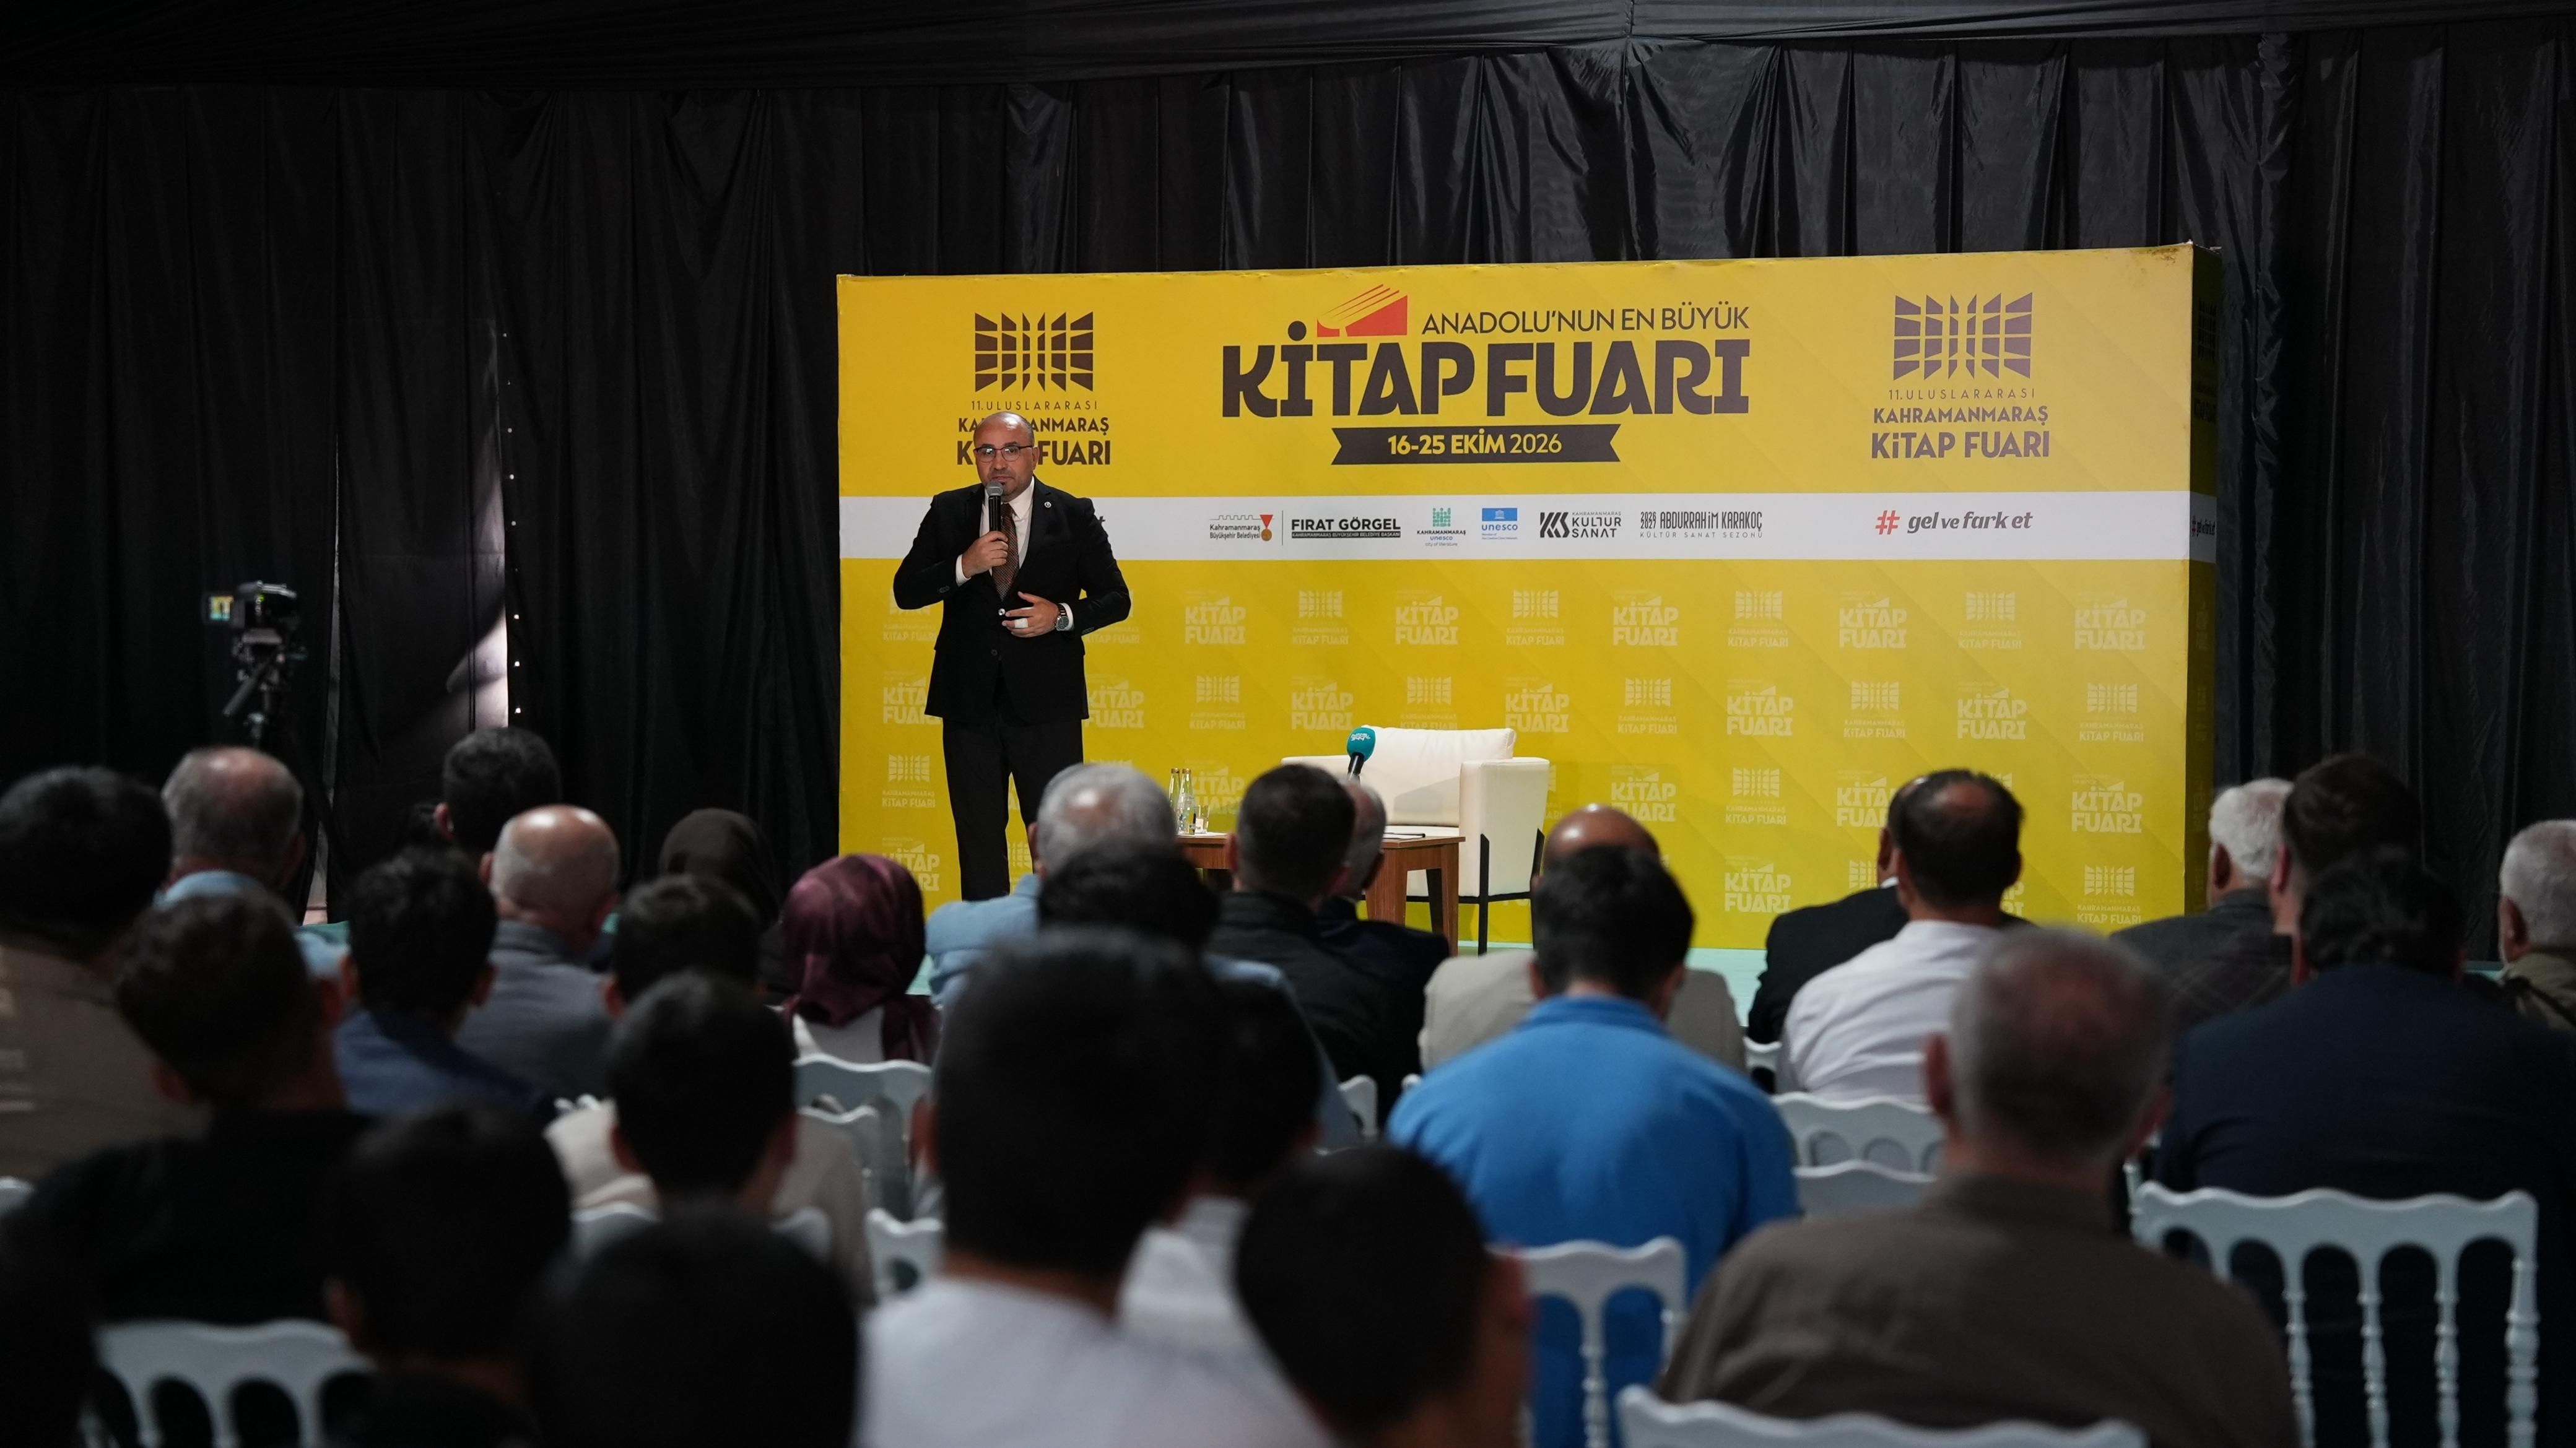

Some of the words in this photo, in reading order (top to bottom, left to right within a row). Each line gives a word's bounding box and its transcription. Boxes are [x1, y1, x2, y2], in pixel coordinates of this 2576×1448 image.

[1422, 309, 1614, 335] ANADOLU'NUN
[1621, 310, 1654, 330] EN
[1661, 302, 1750, 329] BÜYÜK
[1222, 320, 1474, 418] KİTAP
[1487, 339, 1751, 417] FUARI
[1874, 405, 2048, 426] KAHRAMANMARAŞ
[959, 417, 1110, 436] KAANMARAŞ
[1388, 434, 1445, 456] 16-25
[1451, 427, 1506, 455] EKİM
[1510, 433, 1563, 454] 2026
[1964, 431, 2050, 458] FUARI
[1038, 440, 1111, 465] FUARI
[1292, 519, 1334, 531] FIRAT
[1339, 517, 1401, 531] GÖRGEL
[1721, 511, 1762, 532] KARAKOÇ
[1572, 528, 1617, 538] SANAT
[2071, 812, 2143, 833] FUARI
